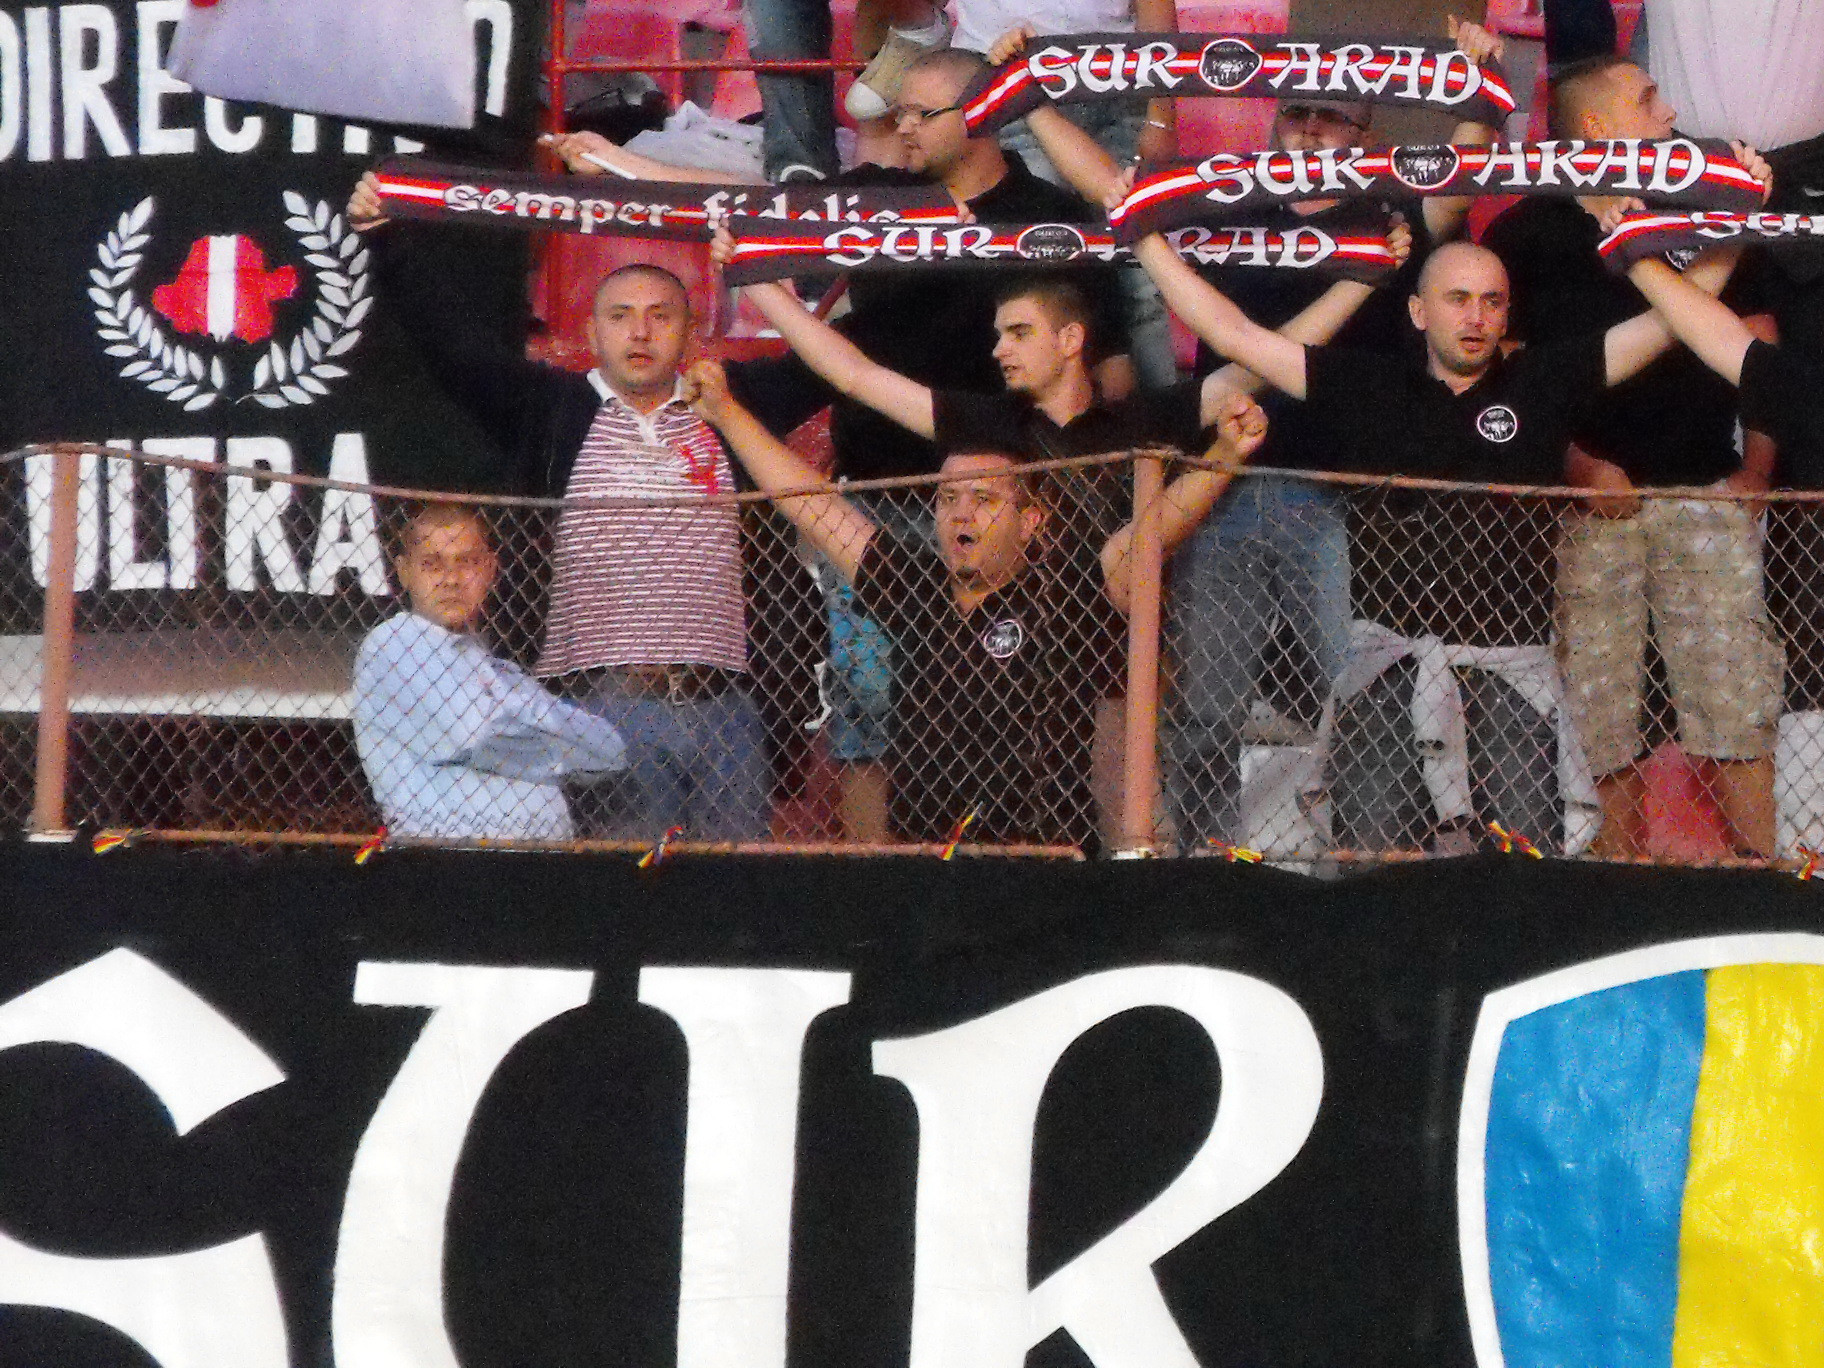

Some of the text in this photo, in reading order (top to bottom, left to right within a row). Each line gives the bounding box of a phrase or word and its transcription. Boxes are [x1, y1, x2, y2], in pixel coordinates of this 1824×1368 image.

[1028, 41, 1483, 106] SUR ARAD
[823, 224, 1002, 267] SUR
[23, 432, 392, 597] ULTRA
